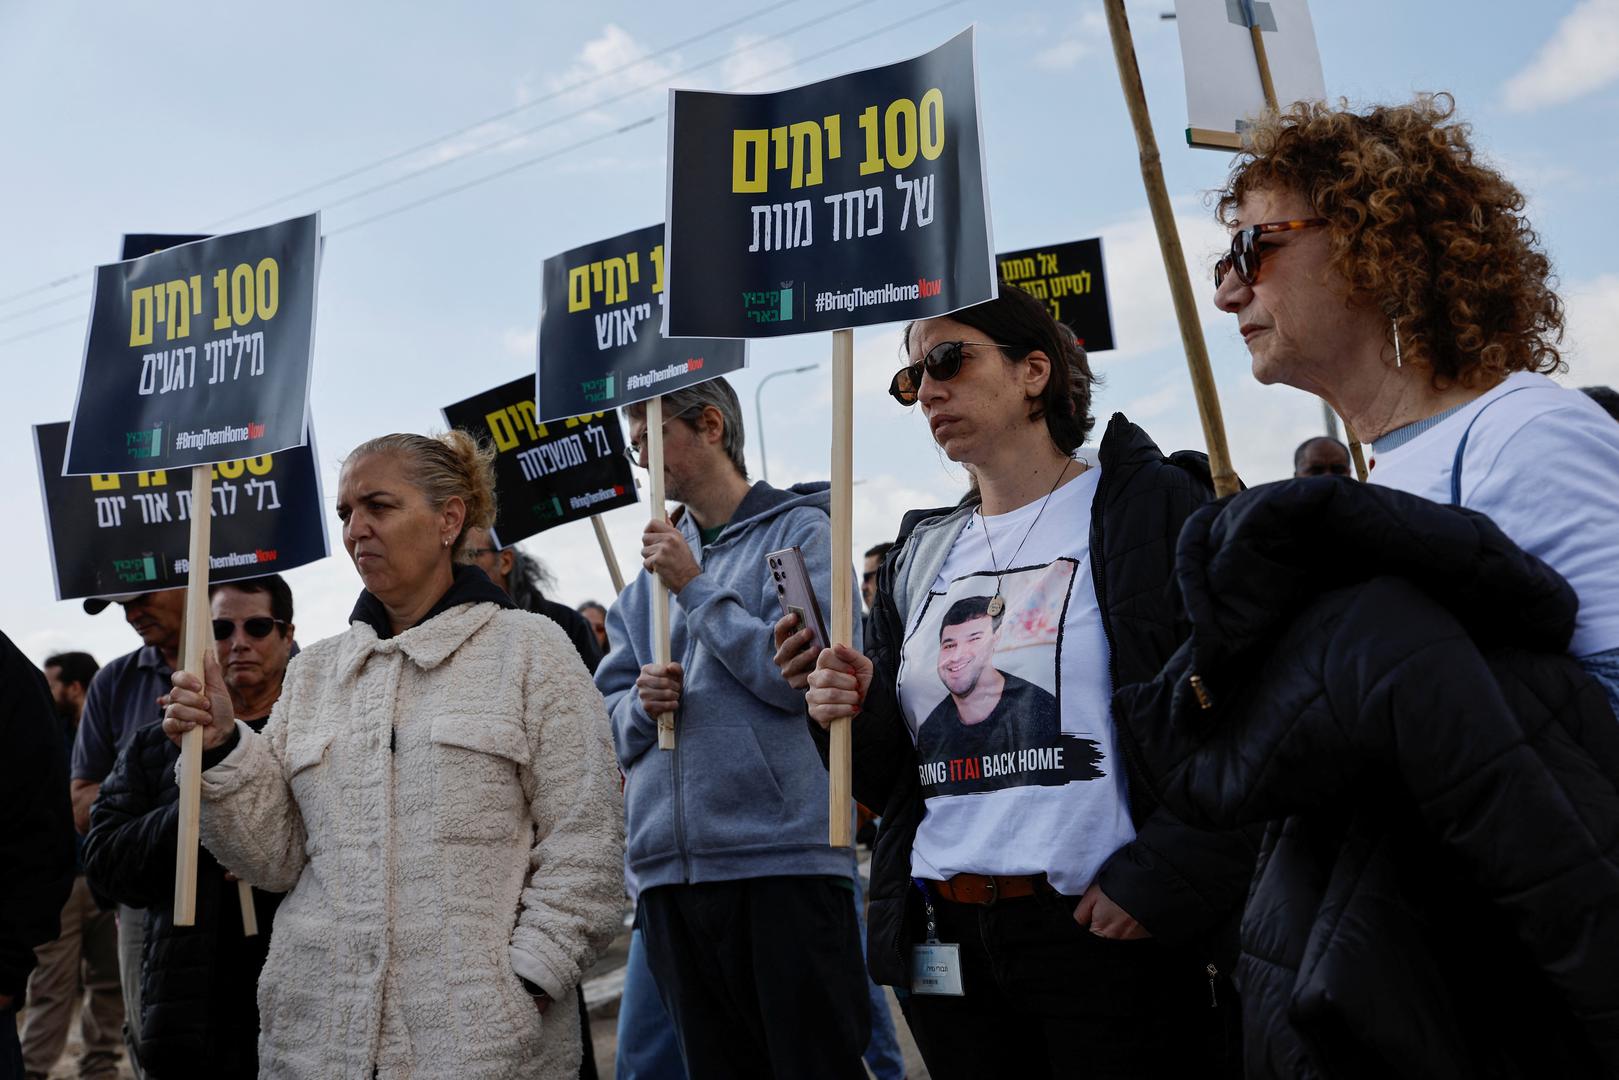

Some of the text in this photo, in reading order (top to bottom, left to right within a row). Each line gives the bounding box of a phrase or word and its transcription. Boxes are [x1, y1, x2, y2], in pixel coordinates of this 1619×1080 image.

[732, 87, 945, 194] 100 ימים
[749, 173, 934, 253] של פחד מוות
[568, 251, 640, 314] ימים
[1037, 252, 1059, 276] אל
[1049, 270, 1091, 298] לסיוט
[129, 257, 279, 347] 100 ימים
[742, 290, 780, 307] קיבוץ
[748, 309, 780, 323] בארי
[815, 278, 943, 312] #BringThemHomeNow
[595, 302, 651, 351] ייאוש
[138, 330, 265, 396] מיליוני רגעים
[626, 357, 704, 391] #BringThemHomeNow
[176, 422, 265, 450] #BringThemHomeNow
[485, 400, 550, 453] מים
[516, 424, 613, 481] בלי המשפחה
[95, 478, 281, 528] בלי לרת אור יום
[918, 747, 1065, 786] RING ITAI BACK HOME
